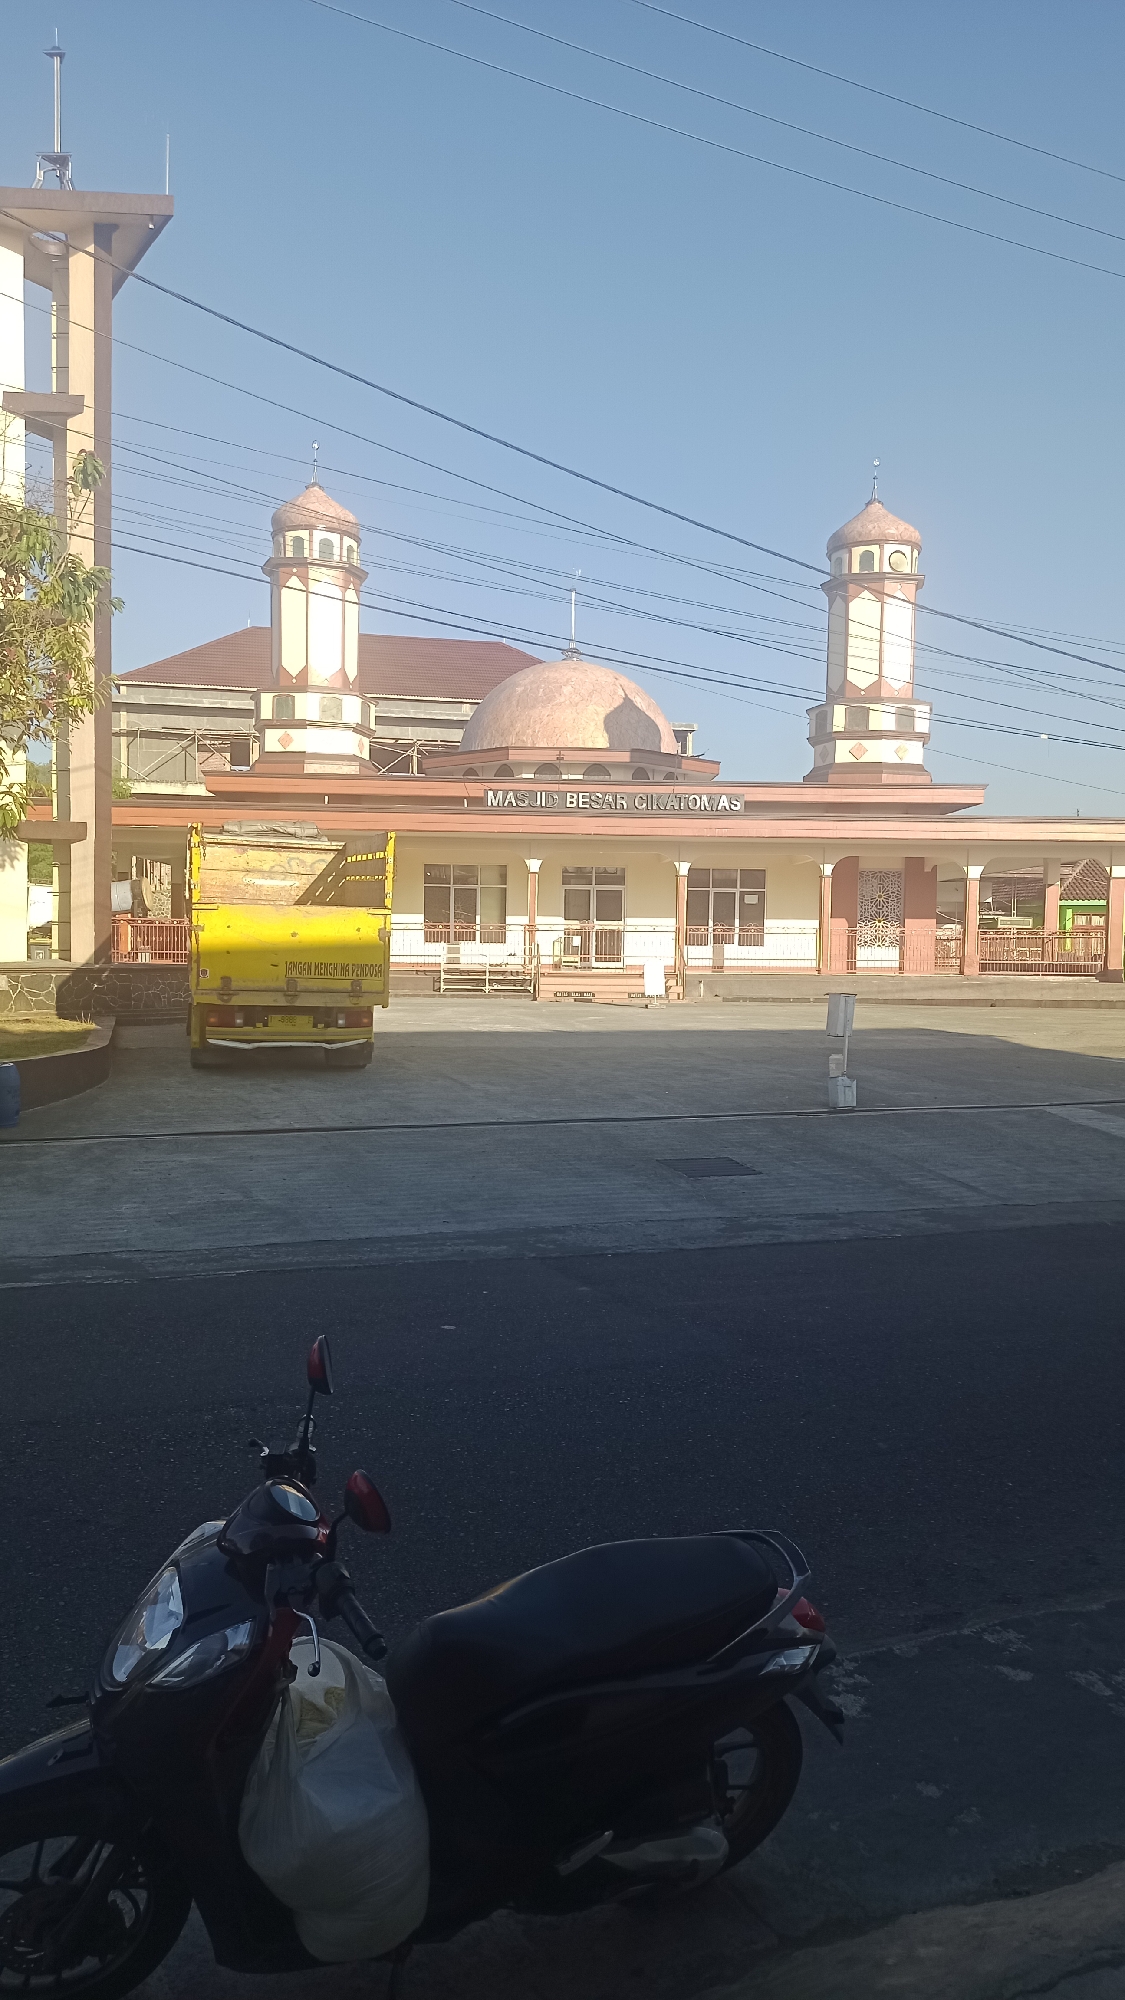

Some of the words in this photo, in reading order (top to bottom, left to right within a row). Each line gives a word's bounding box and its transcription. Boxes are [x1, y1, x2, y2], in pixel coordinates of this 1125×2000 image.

[487, 790, 559, 808] MASJID
[566, 792, 628, 810] BESAR
[633, 793, 741, 811] CIKATOMAS
[285, 961, 312, 977] JANGAN
[351, 963, 383, 978] PENDOSA
